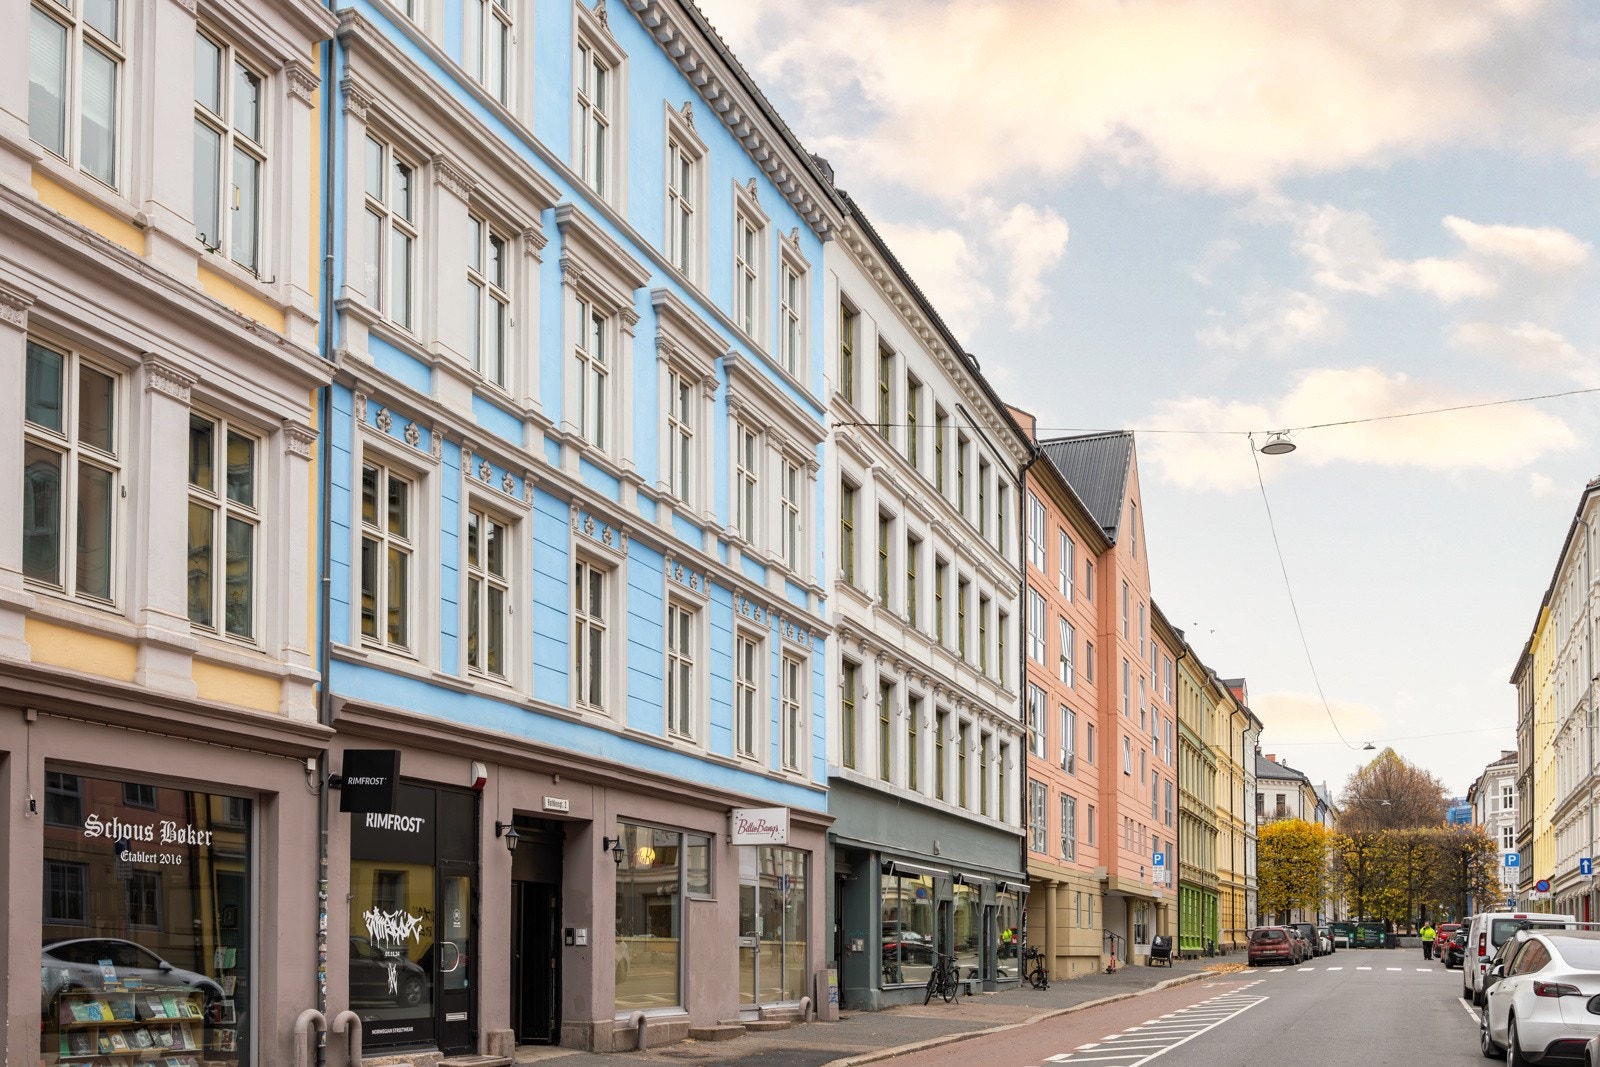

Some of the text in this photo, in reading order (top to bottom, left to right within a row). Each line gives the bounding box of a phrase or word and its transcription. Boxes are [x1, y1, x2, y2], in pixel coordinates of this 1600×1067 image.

[348, 776, 384, 785] RIMFROST
[366, 812, 423, 833] RIMFROST
[84, 813, 213, 847] Schous Bøker
[120, 849, 182, 865] Etablert 2016
[1154, 854, 1161, 864] P
[1508, 855, 1517, 865] P
